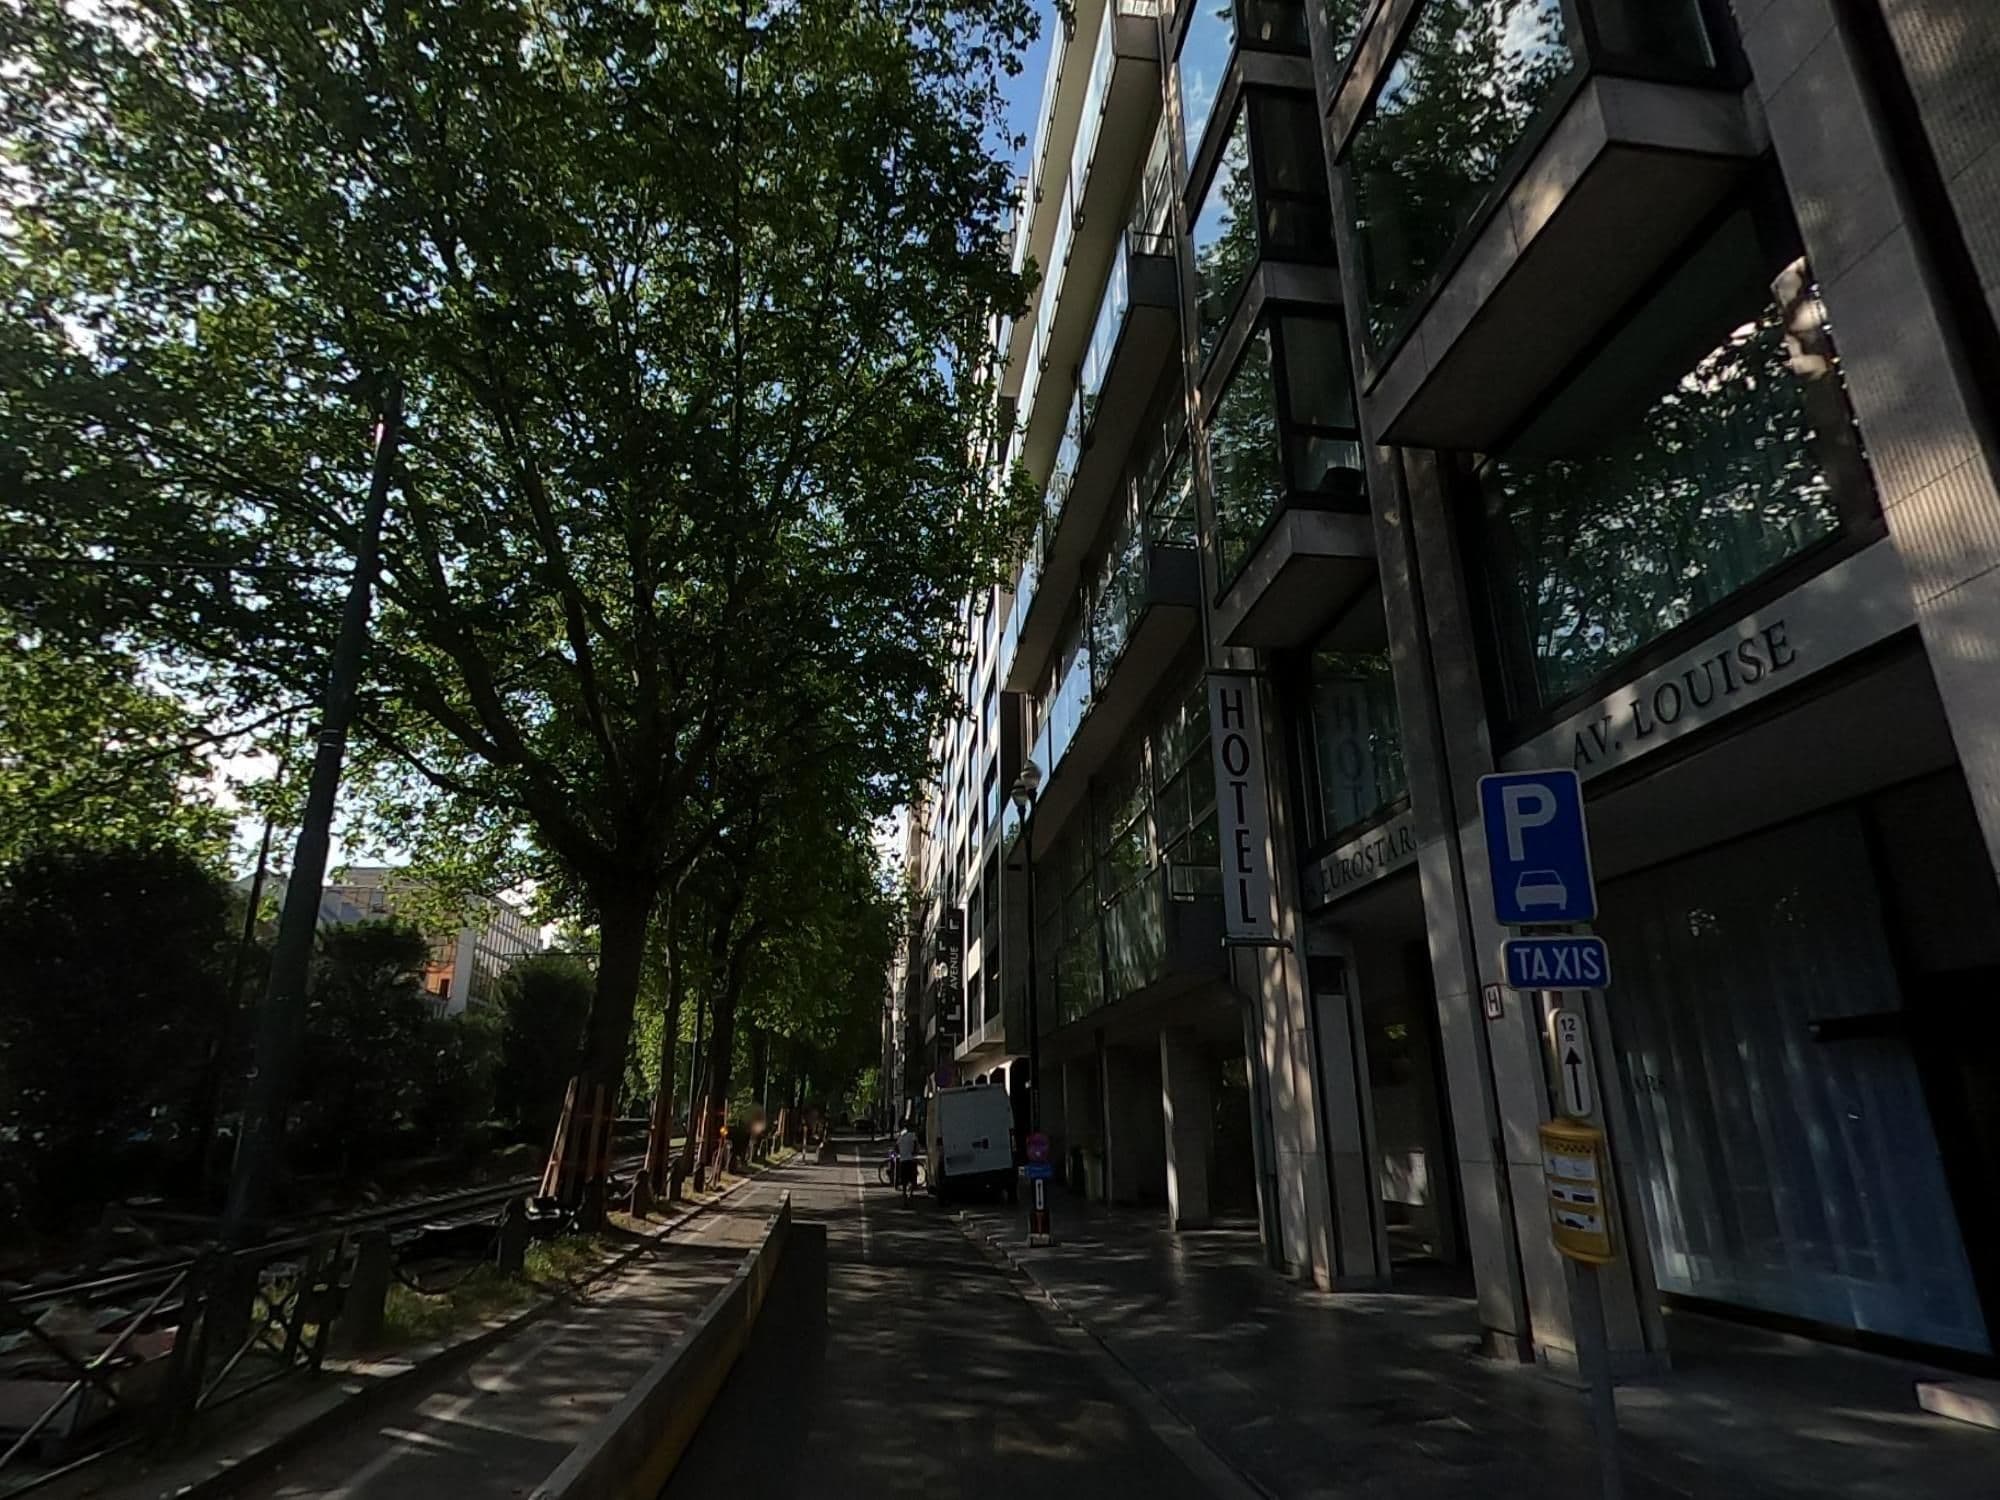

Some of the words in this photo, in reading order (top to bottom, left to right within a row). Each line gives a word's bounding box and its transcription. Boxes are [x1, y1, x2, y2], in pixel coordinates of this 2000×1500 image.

[1574, 715, 1622, 770] AV.
[1630, 619, 1796, 740] LOUISE
[1219, 688, 1257, 924] HOTEL
[1501, 783, 1557, 863] P
[1320, 826, 1418, 893] EUROSTAR
[949, 944, 960, 992] AVENUE
[1511, 945, 1602, 981] TAXIS
[1561, 1018, 1576, 1031] 12
